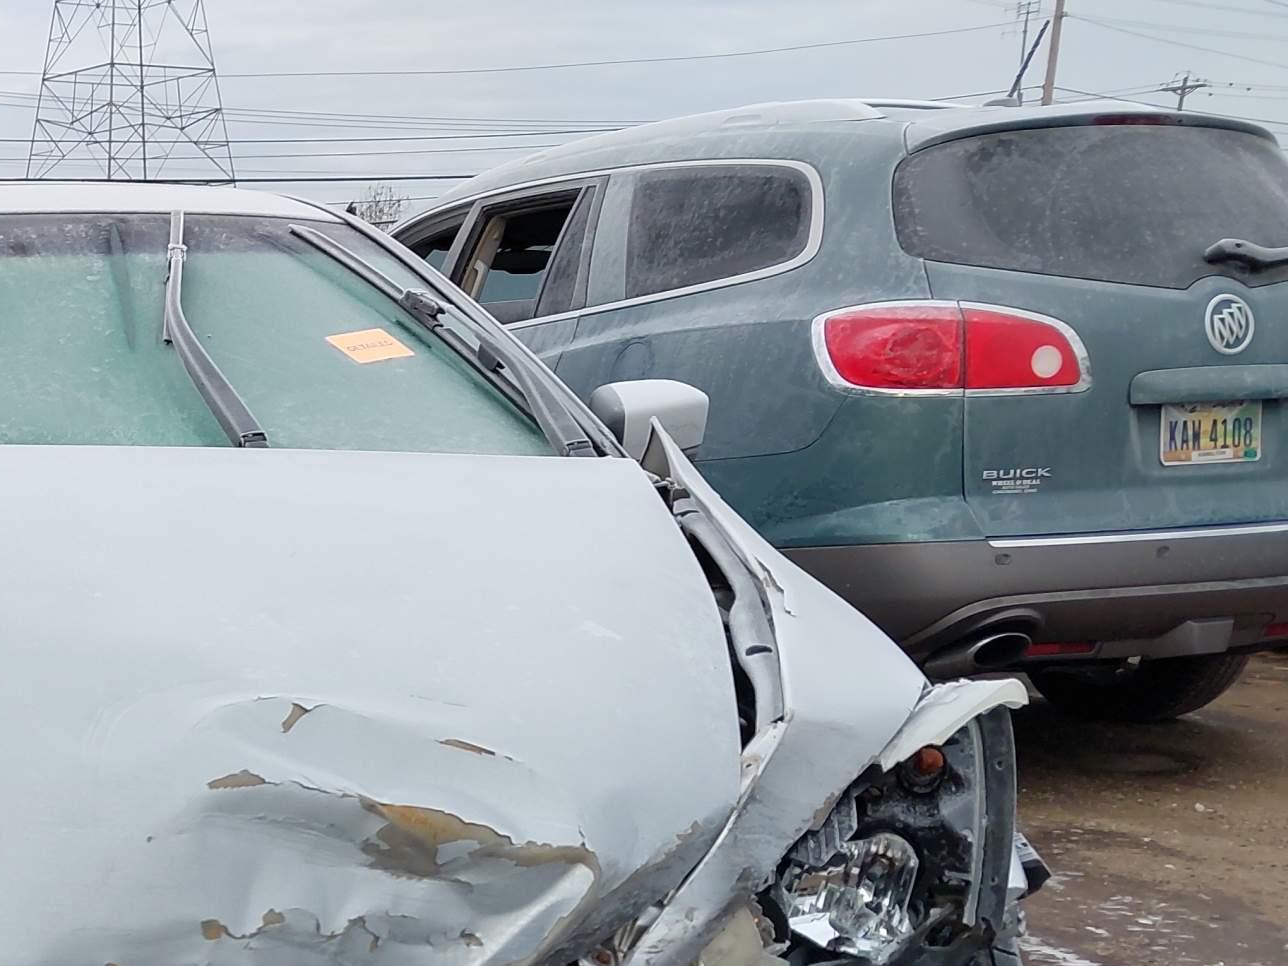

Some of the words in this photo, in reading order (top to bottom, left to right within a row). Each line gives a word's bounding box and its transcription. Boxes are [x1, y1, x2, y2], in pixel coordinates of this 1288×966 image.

[1169, 419, 1201, 451] KAW
[1209, 417, 1253, 449] 4108
[983, 467, 1051, 480] BUICK
